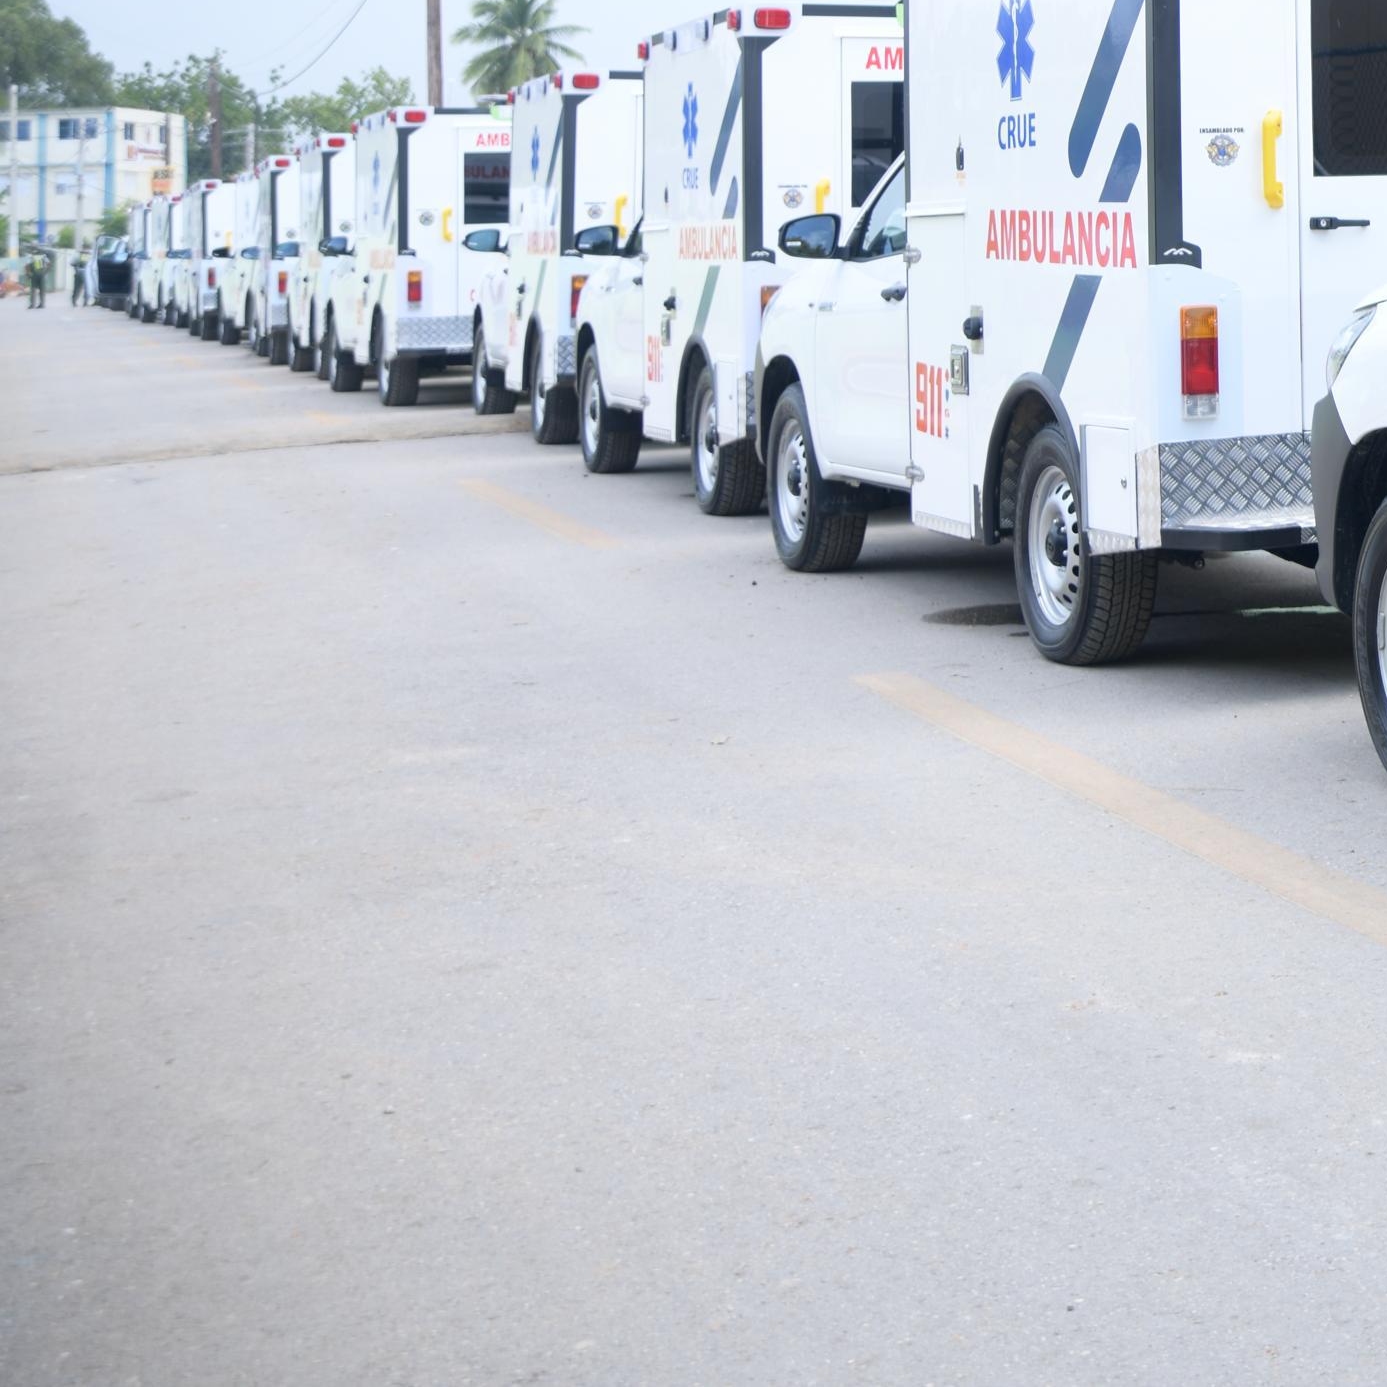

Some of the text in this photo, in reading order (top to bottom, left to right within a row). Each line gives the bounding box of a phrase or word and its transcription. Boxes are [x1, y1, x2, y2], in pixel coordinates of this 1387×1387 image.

[997, 112, 1037, 151] CRUE
[682, 167, 699, 191] CRUE
[678, 225, 738, 261] AMBULANCIA
[986, 207, 1138, 269] AMBULANCIA
[916, 361, 943, 439] 911
